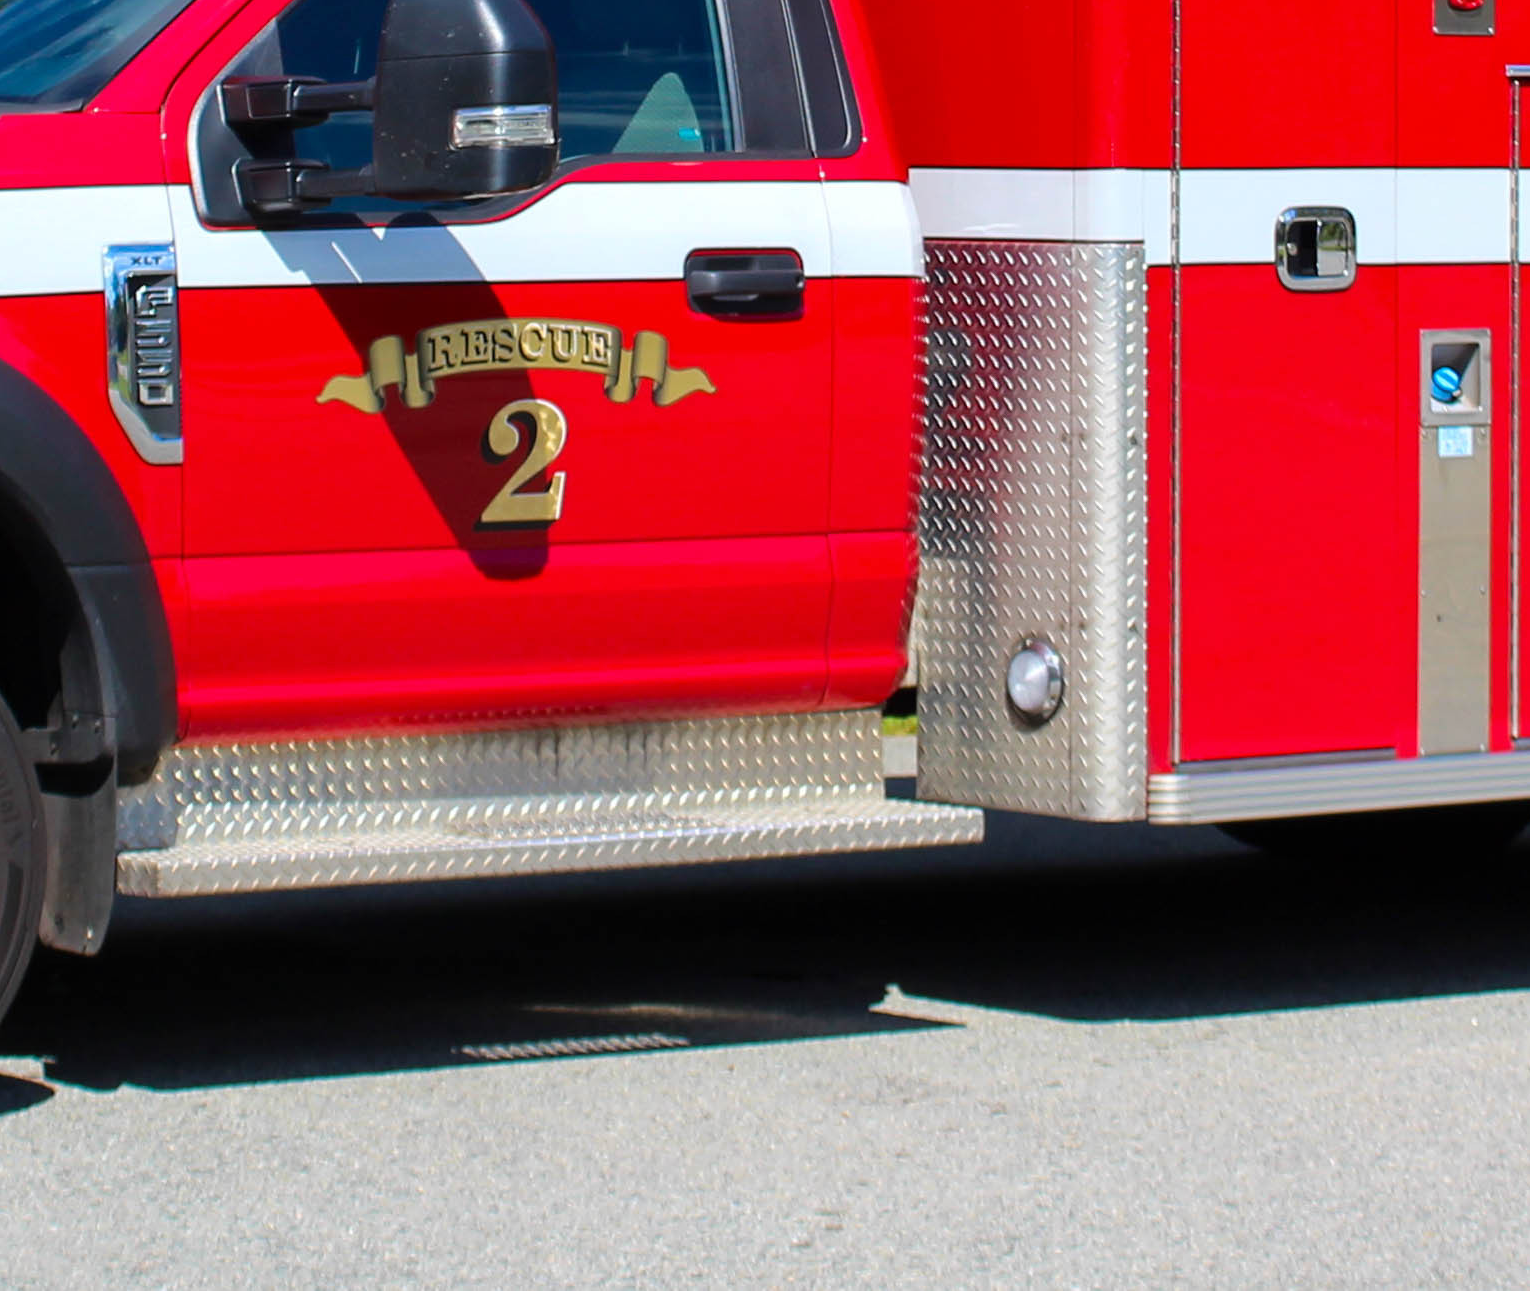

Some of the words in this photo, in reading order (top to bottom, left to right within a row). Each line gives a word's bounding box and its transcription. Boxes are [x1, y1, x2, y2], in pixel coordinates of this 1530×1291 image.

[130, 255, 162, 266] XLT
[427, 322, 613, 373] RESCUE
[477, 398, 568, 528] 2
